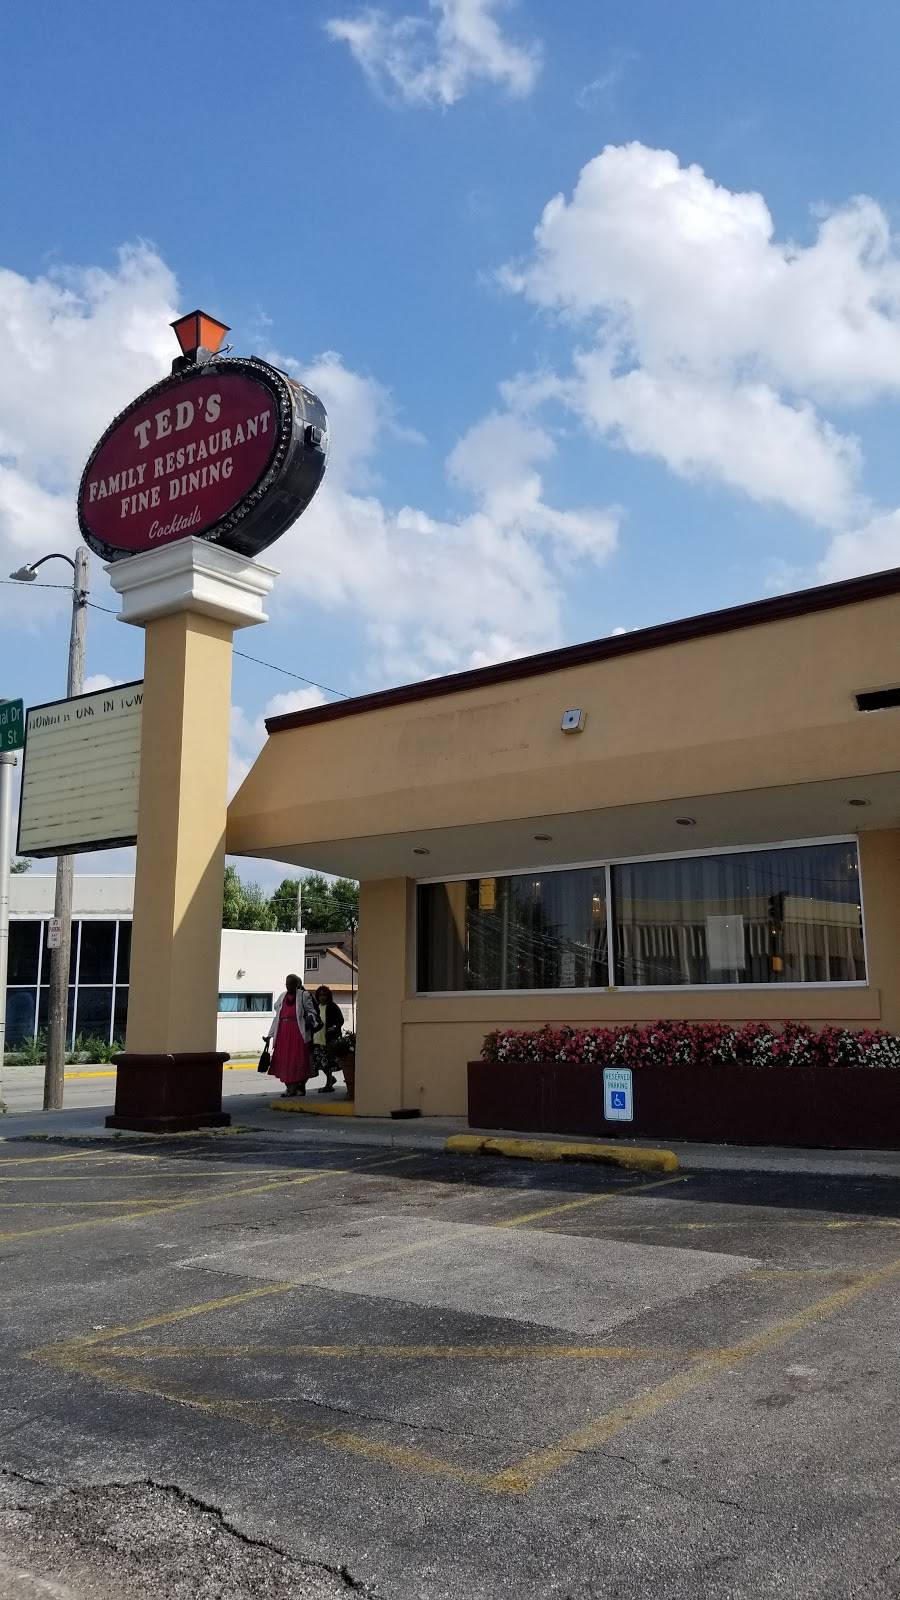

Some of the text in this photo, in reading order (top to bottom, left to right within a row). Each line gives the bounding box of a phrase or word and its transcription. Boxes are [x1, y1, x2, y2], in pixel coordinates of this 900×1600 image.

[134, 393, 222, 450] TED'S
[88, 410, 271, 503] FAMILY RESTAURANT
[120, 456, 234, 518] FINE DINING
[148, 504, 202, 539] Cocktails
[0, 708, 9, 724] al
[11, 706, 21, 722] Dr
[103, 699, 114, 713] IN
[7, 727, 17, 744] St
[605, 1072, 630, 1081] RESERVED
[607, 1081, 628, 1090] PARKING
